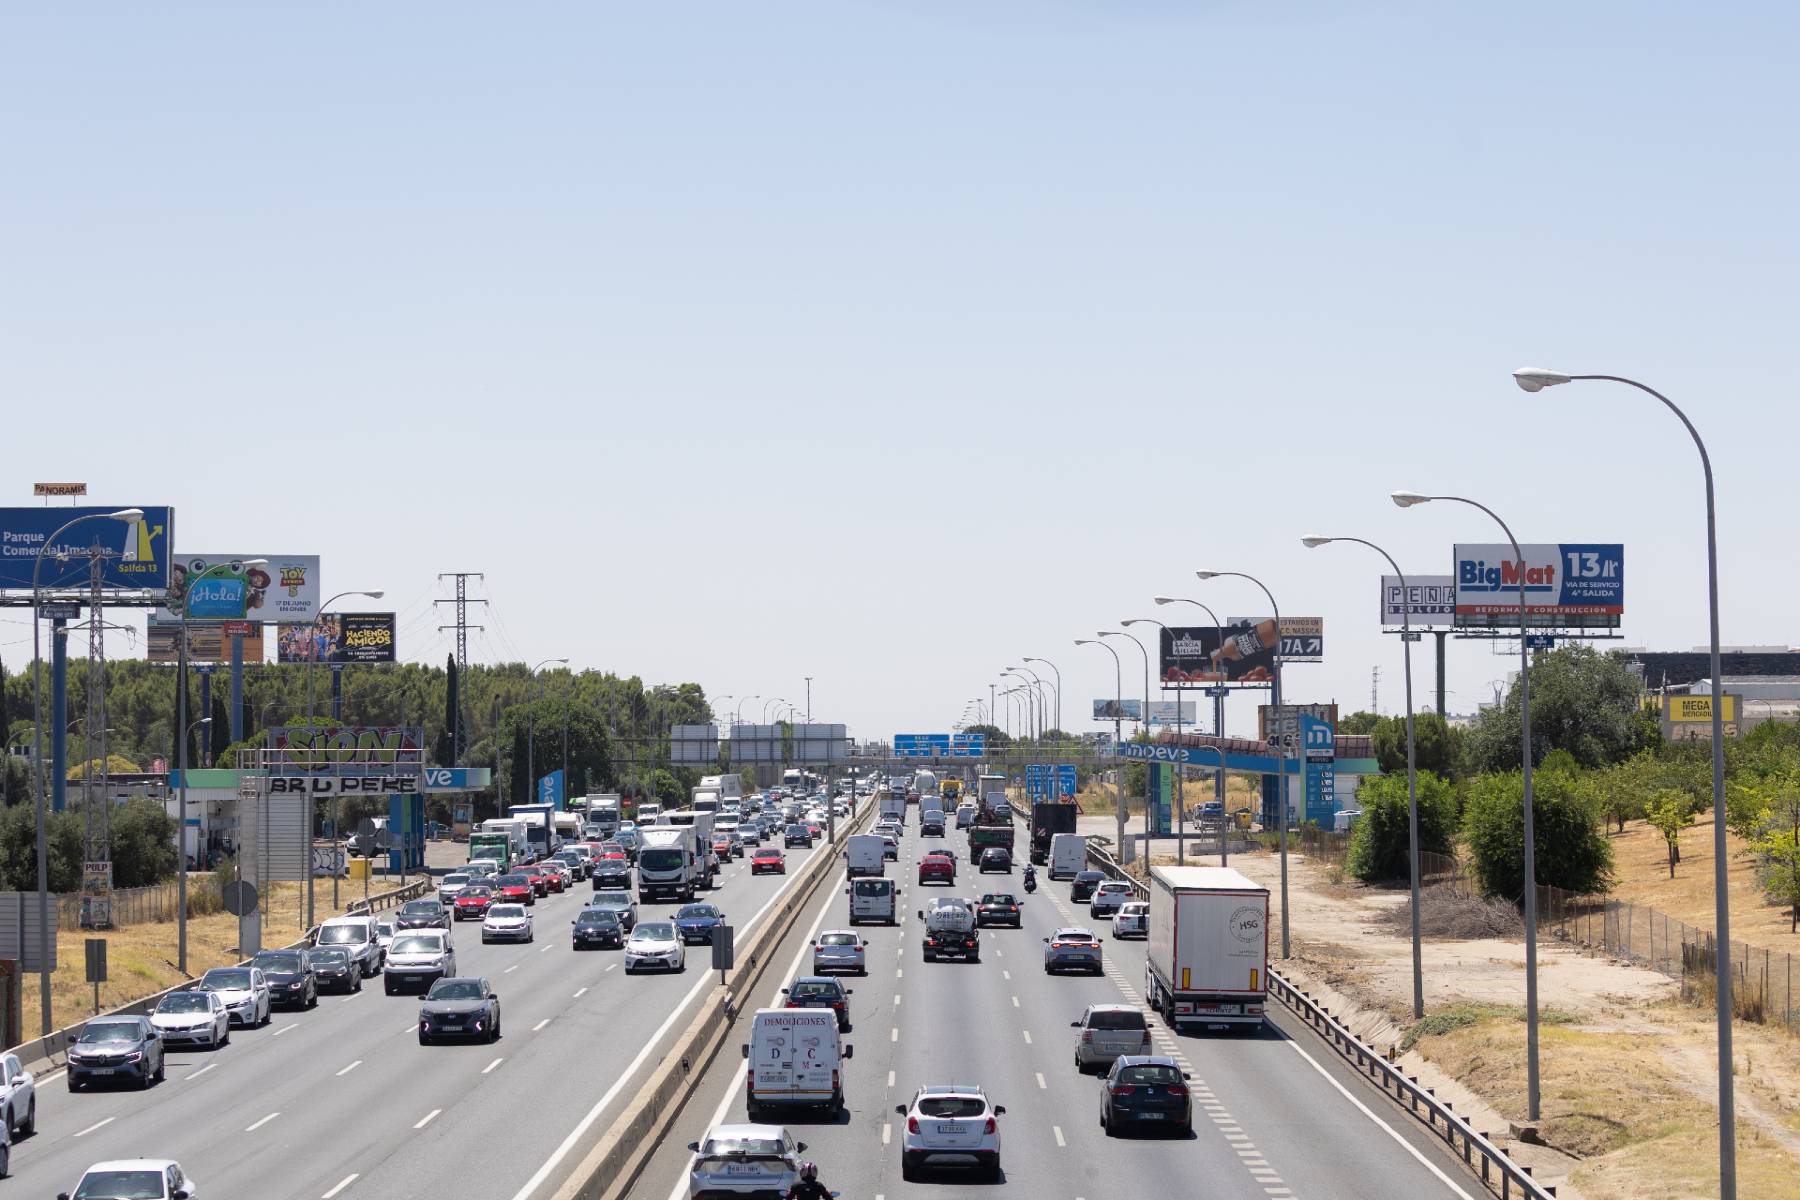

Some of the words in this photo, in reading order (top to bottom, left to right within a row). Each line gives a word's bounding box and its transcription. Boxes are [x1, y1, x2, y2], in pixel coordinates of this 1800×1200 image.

[35, 485, 86, 495] PANORAMIX
[3, 532, 45, 544] Parque
[118, 564, 145, 573] Salida
[149, 564, 157, 572] 13
[1567, 552, 1600, 577] 13
[281, 567, 306, 580] TOY
[1460, 560, 1555, 592] BigMat
[192, 586, 241, 605] ¡Hola!
[346, 629, 390, 638] HACIENDO
[346, 636, 391, 646] AMIGOS
[1682, 701, 1710, 710] MEGA
[1128, 744, 1190, 761] moeve
[1240, 920, 1258, 930] HSG
[764, 1017, 826, 1026] DEMOLICIONES
[771, 1048, 780, 1059] D
[808, 1048, 816, 1059] C
